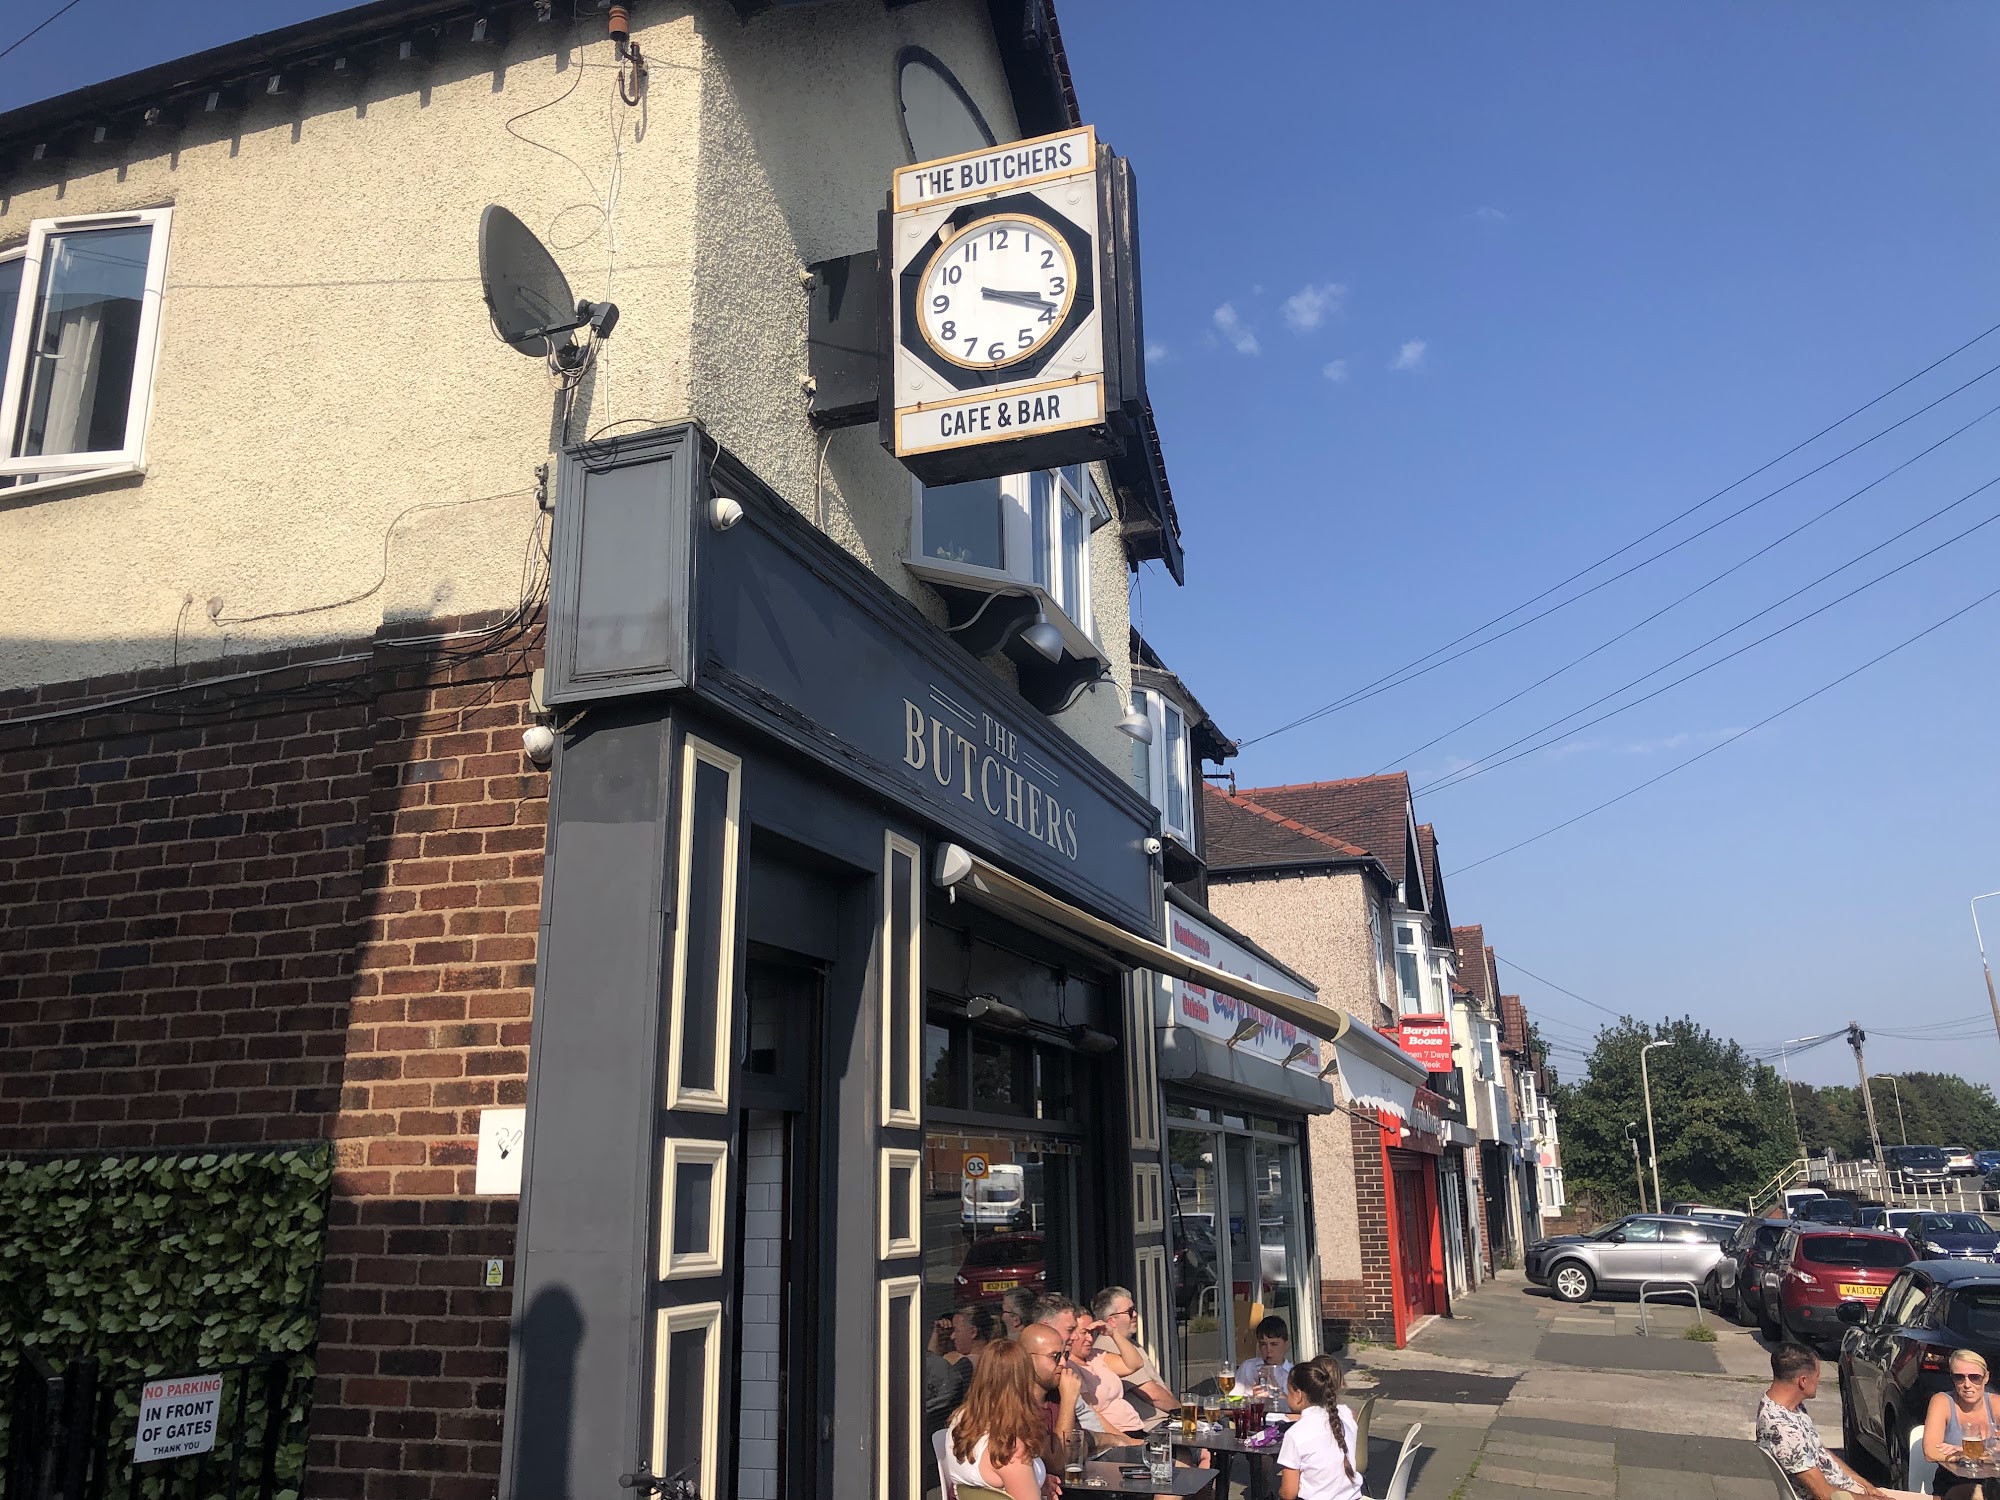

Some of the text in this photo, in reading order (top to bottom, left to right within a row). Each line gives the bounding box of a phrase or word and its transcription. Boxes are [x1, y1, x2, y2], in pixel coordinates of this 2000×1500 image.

[915, 143, 1072, 197] THE BUTCHERS
[989, 230, 1008, 251] 12
[965, 242, 977, 262] 11
[1041, 250, 1054, 269] 2
[942, 265, 962, 285] 10
[1049, 276, 1065, 296] 3
[933, 295, 949, 314] 9
[1038, 305, 1055, 325] 4
[941, 321, 956, 341] 8
[1018, 328, 1034, 348] 5
[964, 337, 978, 357] 7
[988, 342, 1005, 360] 6
[941, 395, 1060, 437] CAFE & BAR
[982, 712, 1019, 764] THE
[902, 698, 1078, 861] BUTCHERS
[1182, 994, 1209, 1024] Cuisine
[1402, 1026, 1448, 1036] Bargain
[1408, 1036, 1443, 1045] Booze
[1430, 1051, 1449, 1059] Days
[1846, 1286, 1864, 1294] VA13
[145, 1380, 220, 1398] NO PARKING
[146, 1401, 214, 1421] IN FRONT
[142, 1420, 212, 1442] OF GATES
[153, 1441, 200, 1455] THANK YOU
